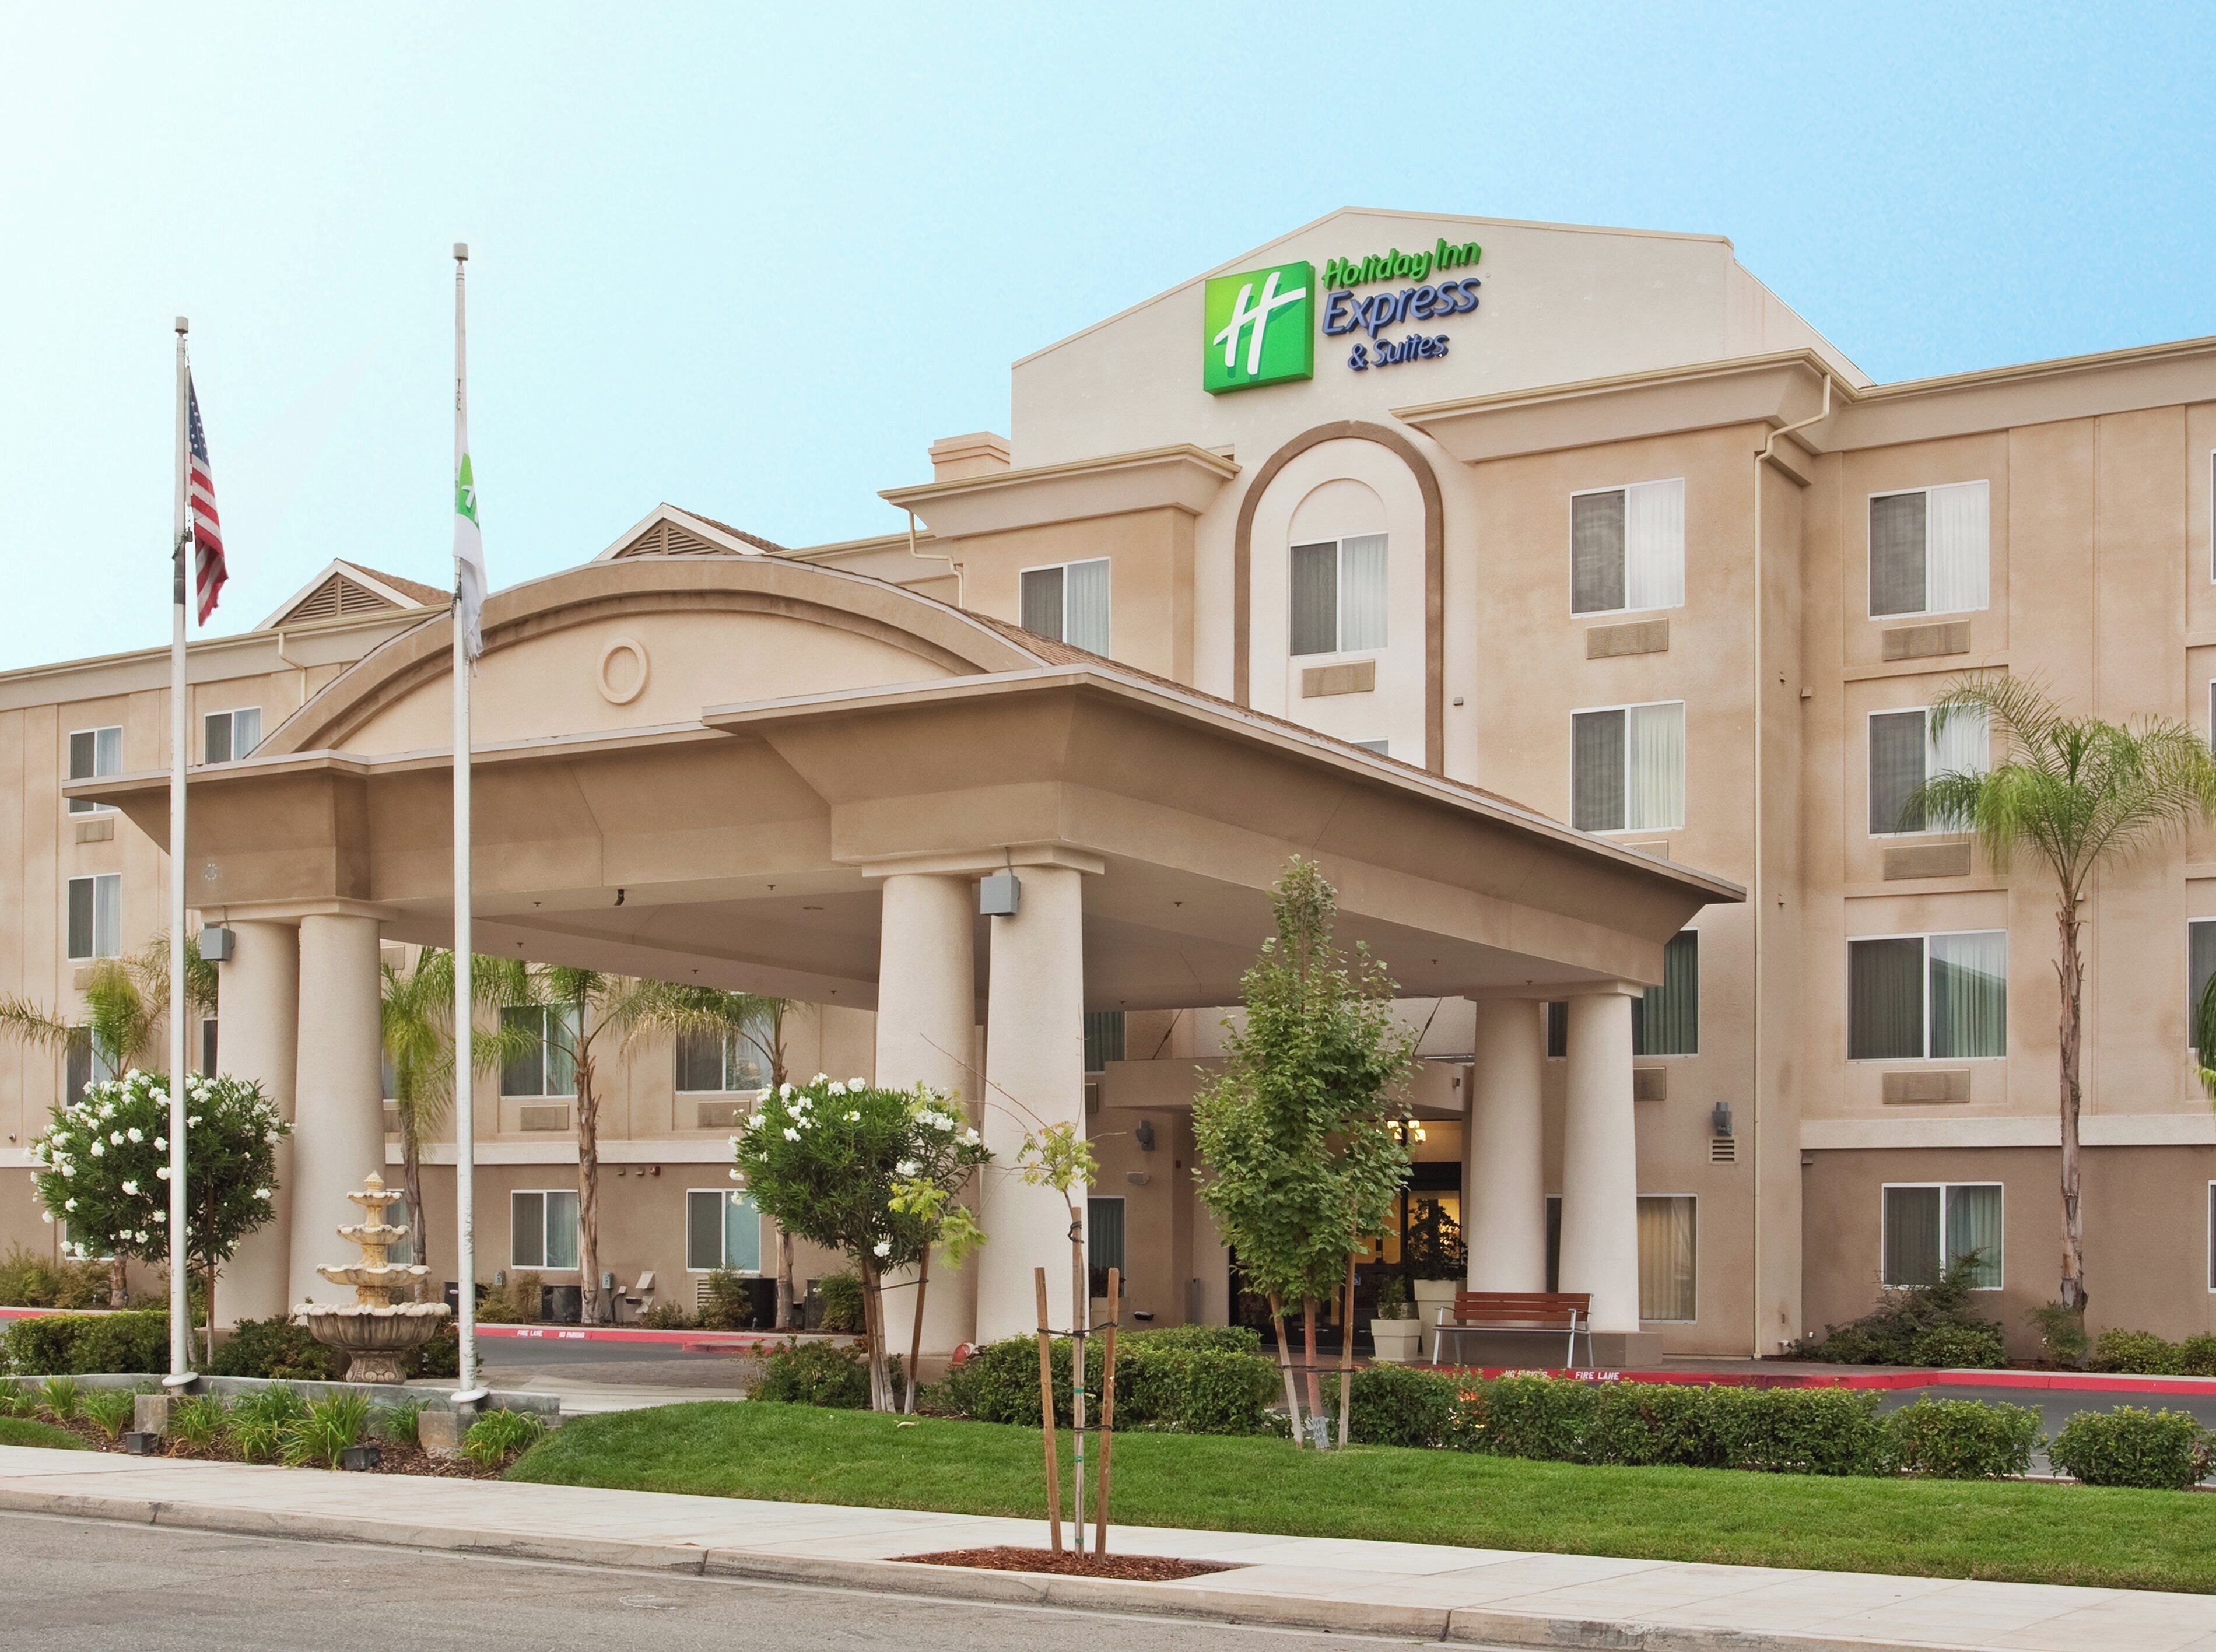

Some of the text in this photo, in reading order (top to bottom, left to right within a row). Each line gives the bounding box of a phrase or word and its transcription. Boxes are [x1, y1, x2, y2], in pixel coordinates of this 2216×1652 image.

[1321, 238, 1481, 291] Holiday Inn
[1322, 278, 1481, 339] Express
[1348, 334, 1449, 371] & Suites
[1575, 1371, 1619, 1380] FIRE LANE
